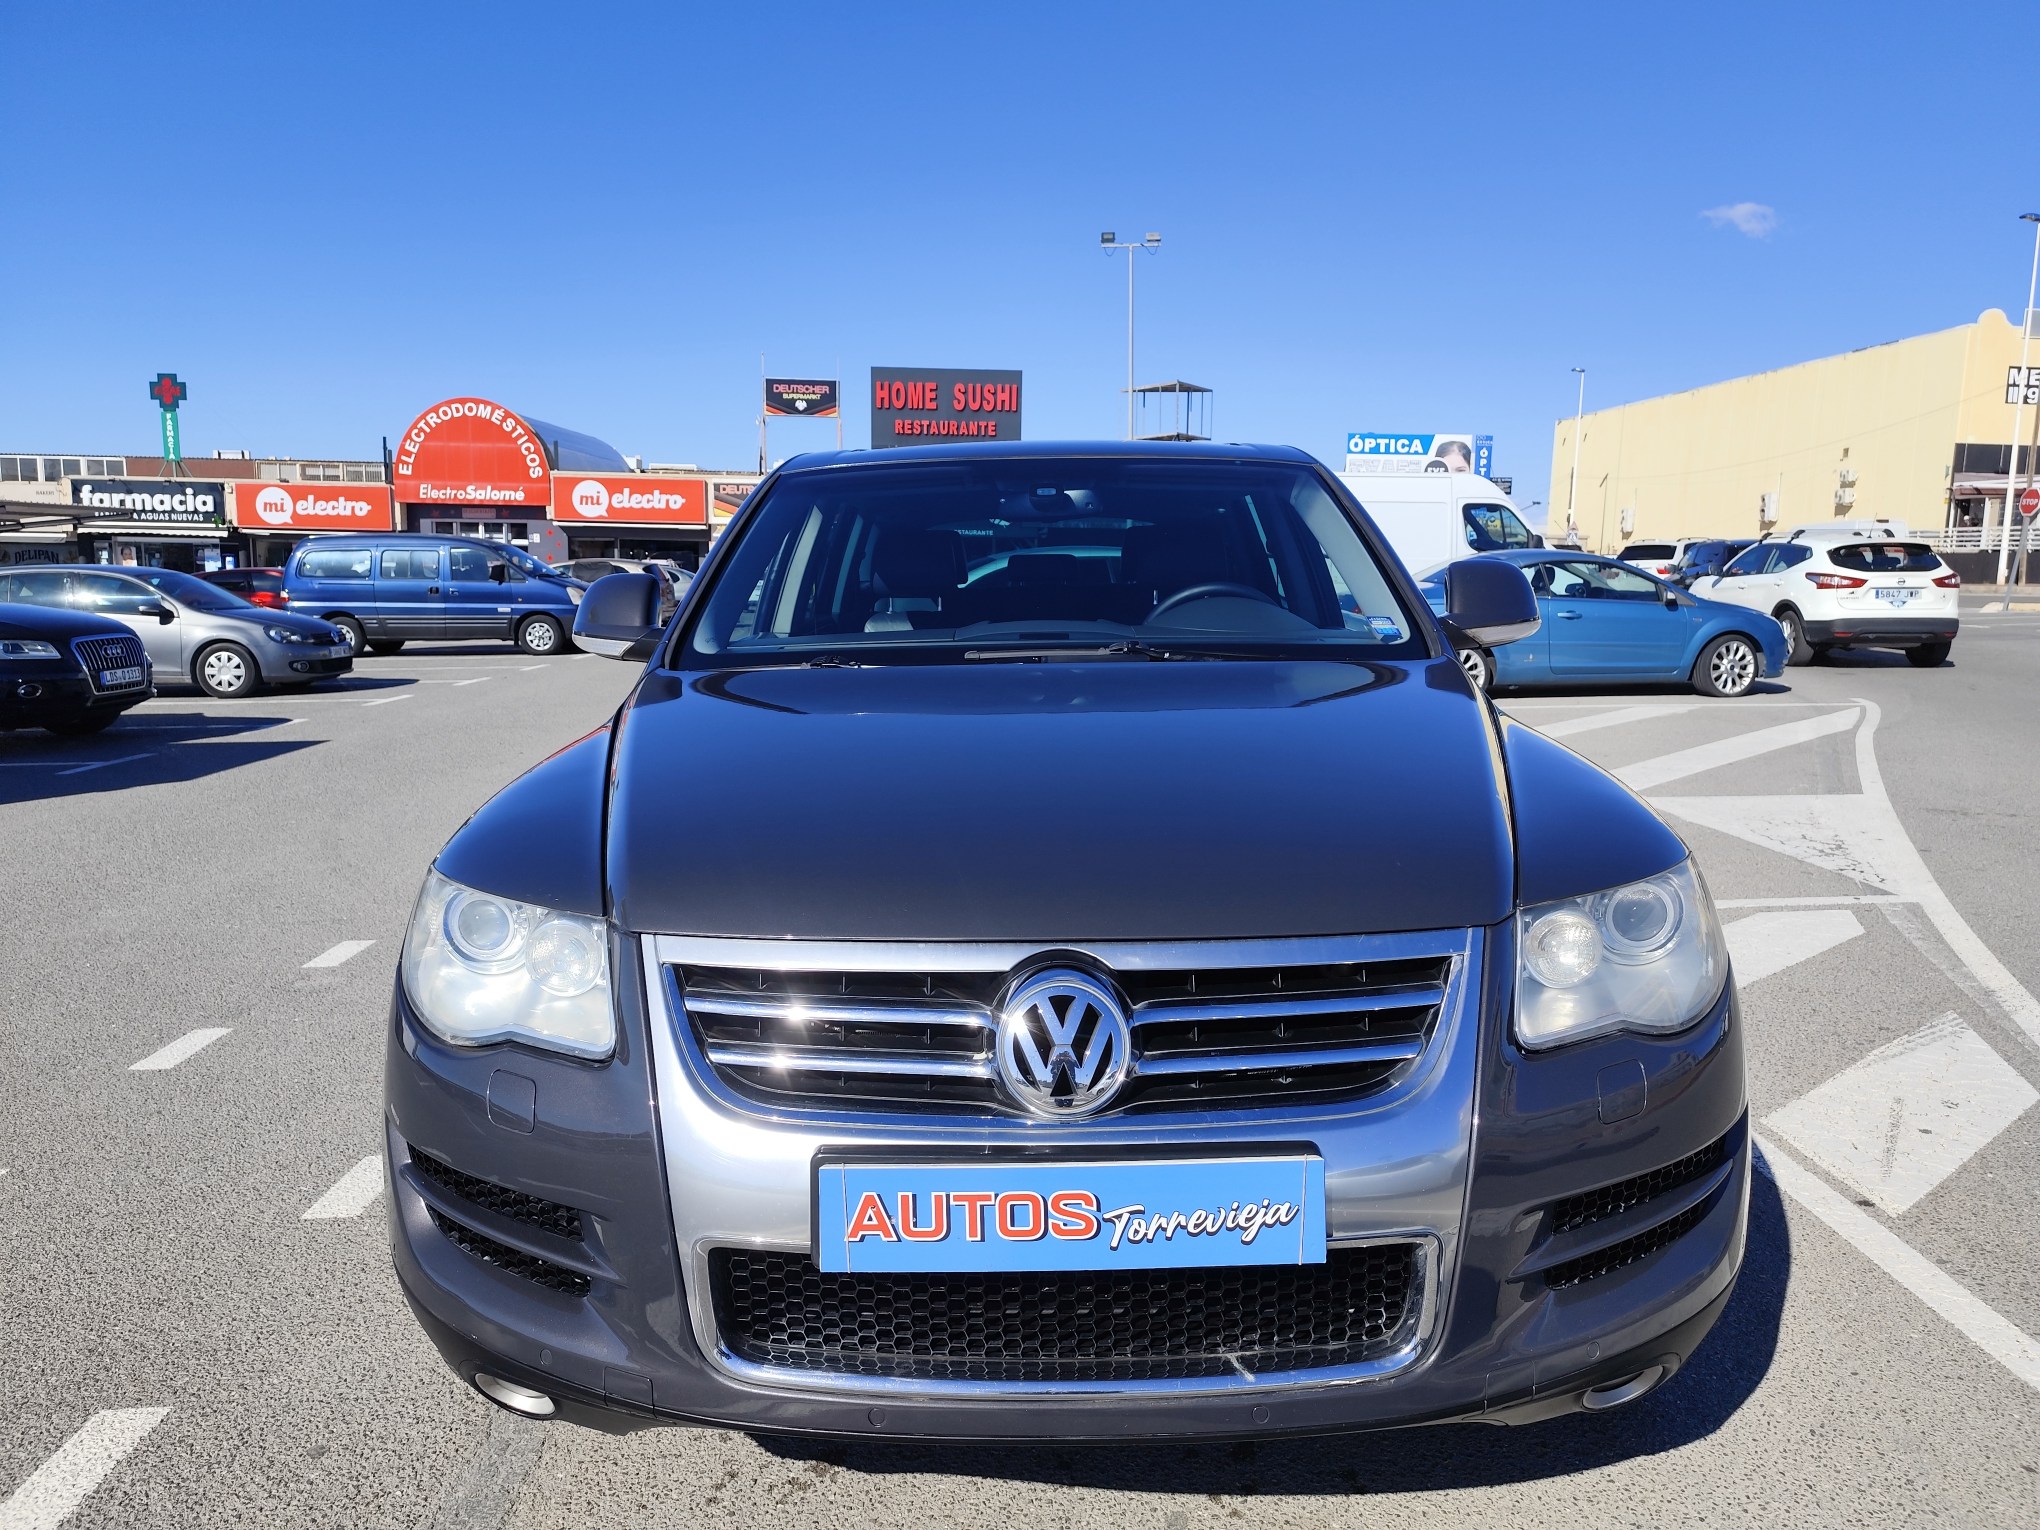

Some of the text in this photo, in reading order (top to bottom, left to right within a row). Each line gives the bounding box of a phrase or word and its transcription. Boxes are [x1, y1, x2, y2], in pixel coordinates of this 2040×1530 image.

[773, 384, 830, 394] DEUTSCHER
[875, 381, 1018, 412] HOME SUSHI
[165, 413, 175, 460] FARMACIA
[894, 419, 997, 437] RESTAURANTE
[398, 402, 543, 479] ELECTRODOMÉSTICOS
[1349, 434, 1424, 454] ÓPTICA
[80, 484, 215, 512] farmacia
[263, 494, 372, 517] mi electro
[580, 487, 686, 510] mi electro
[2022, 498, 2038, 506] STOP
[140, 512, 169, 520] AGUAS
[171, 513, 204, 521] NUEVAS
[14, 549, 60, 565] DELIPAN
[1880, 590, 1901, 598] 5847
[846, 1190, 1299, 1250] AUTOS Torrevieja
